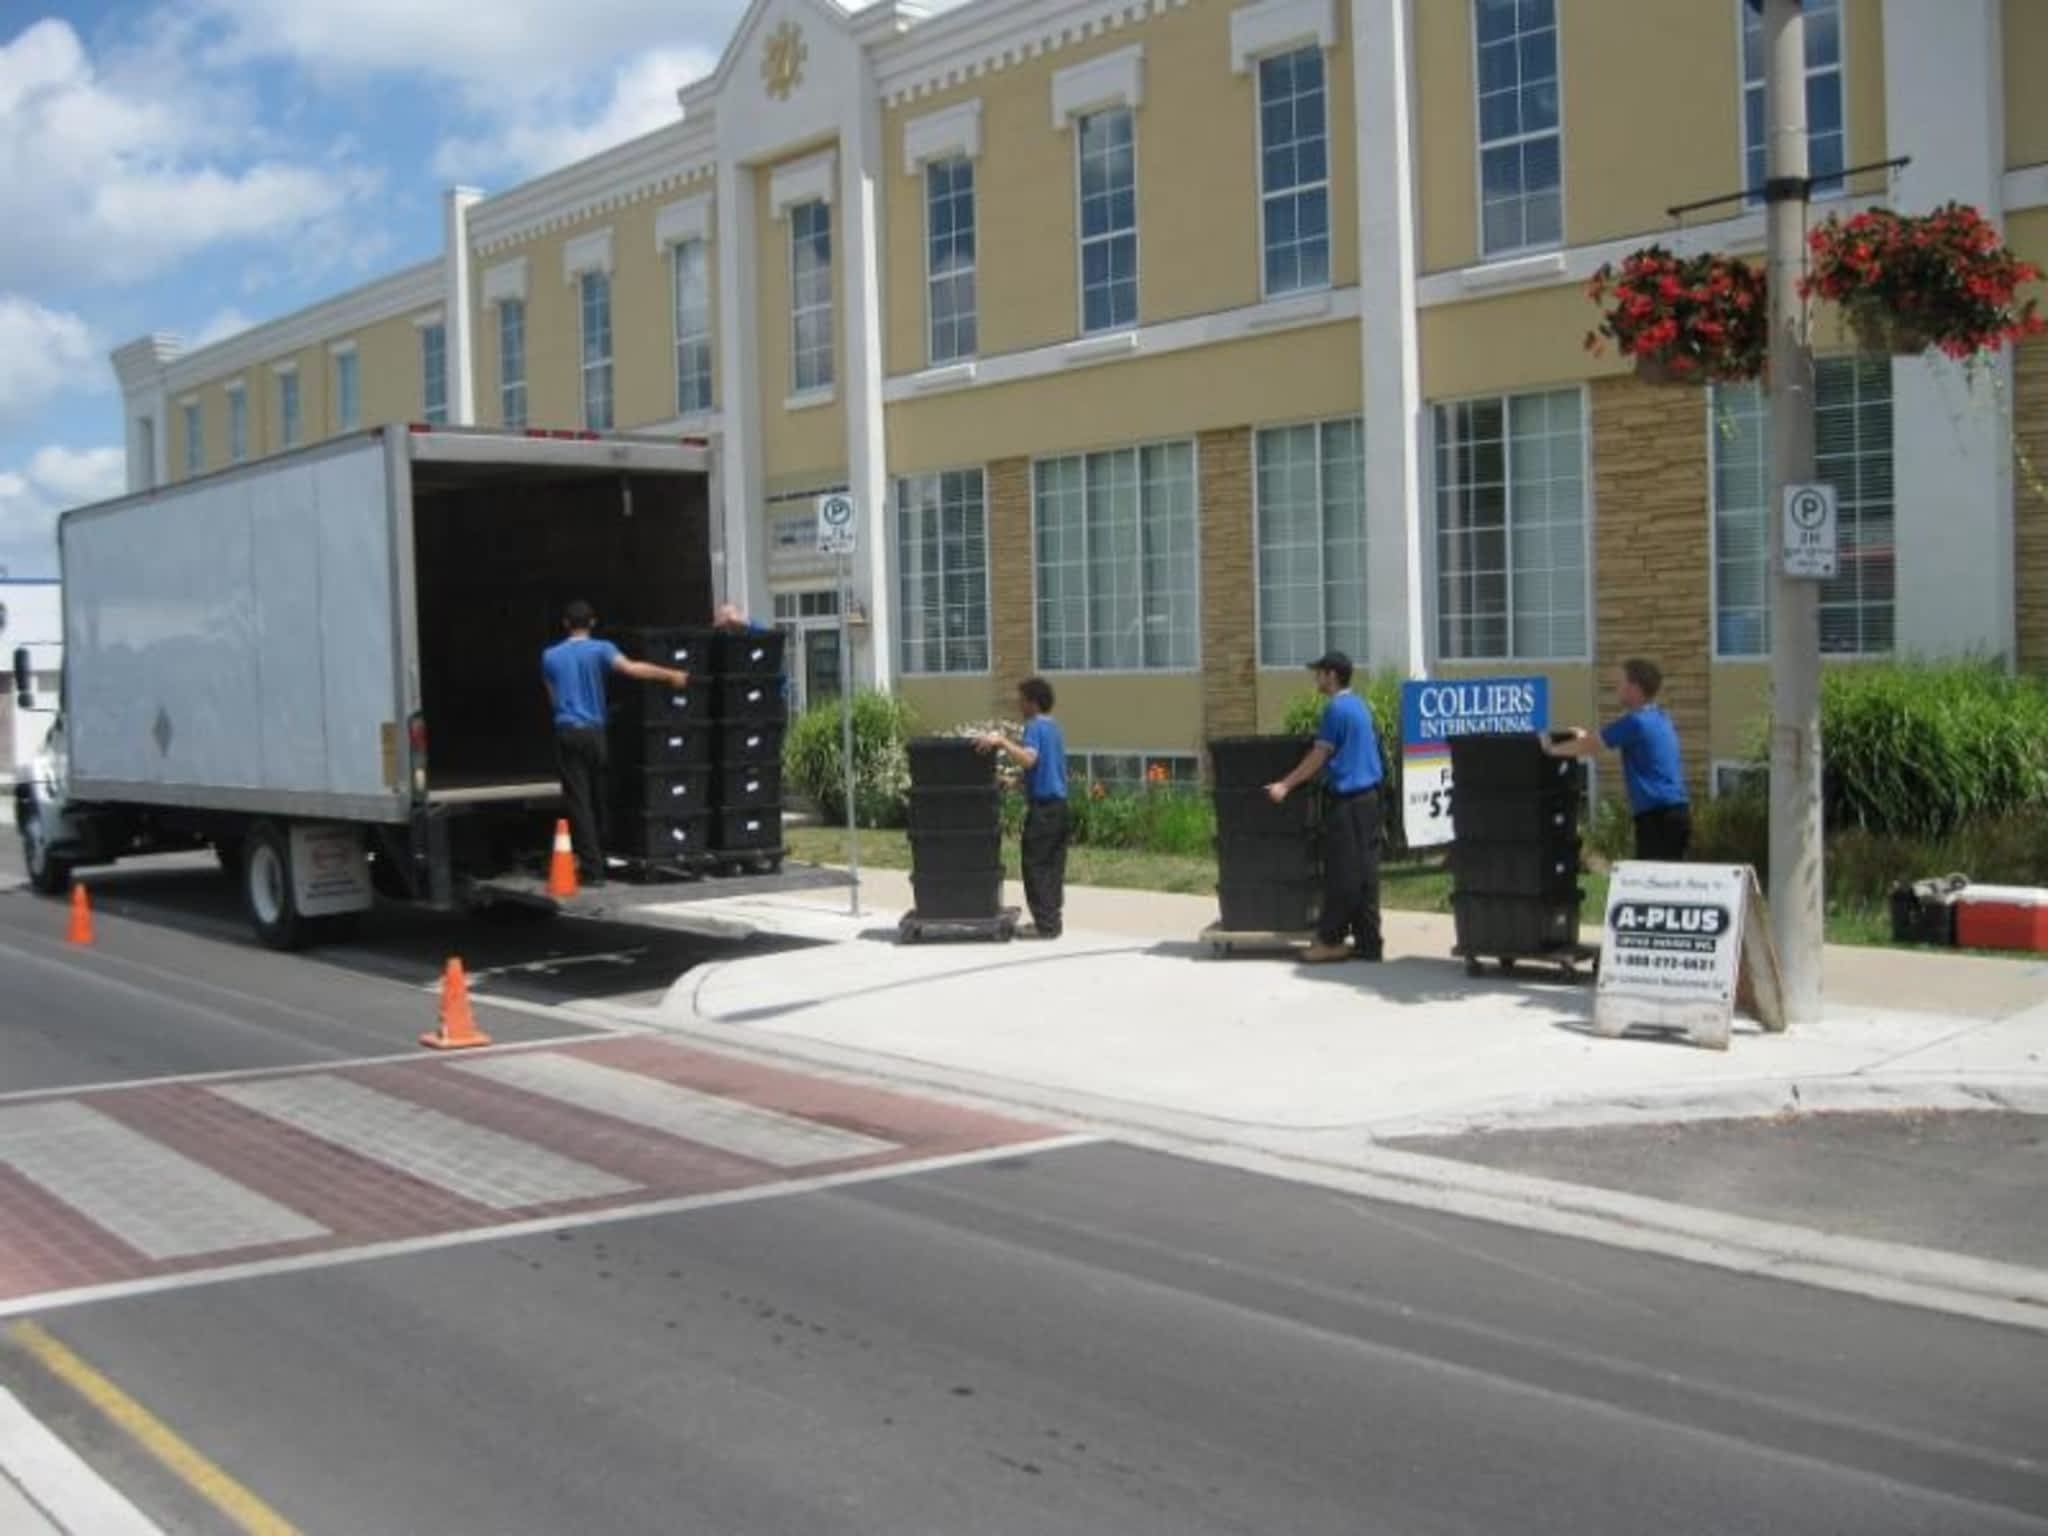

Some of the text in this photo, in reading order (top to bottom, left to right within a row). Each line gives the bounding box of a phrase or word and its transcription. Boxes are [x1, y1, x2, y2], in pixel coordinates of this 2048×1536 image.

[1802, 498, 1818, 519] P
[1420, 683, 1535, 718] COLLIERS
[1420, 715, 1536, 738] INTERNATIONAL
[1617, 906, 1719, 932] A-PLUS
